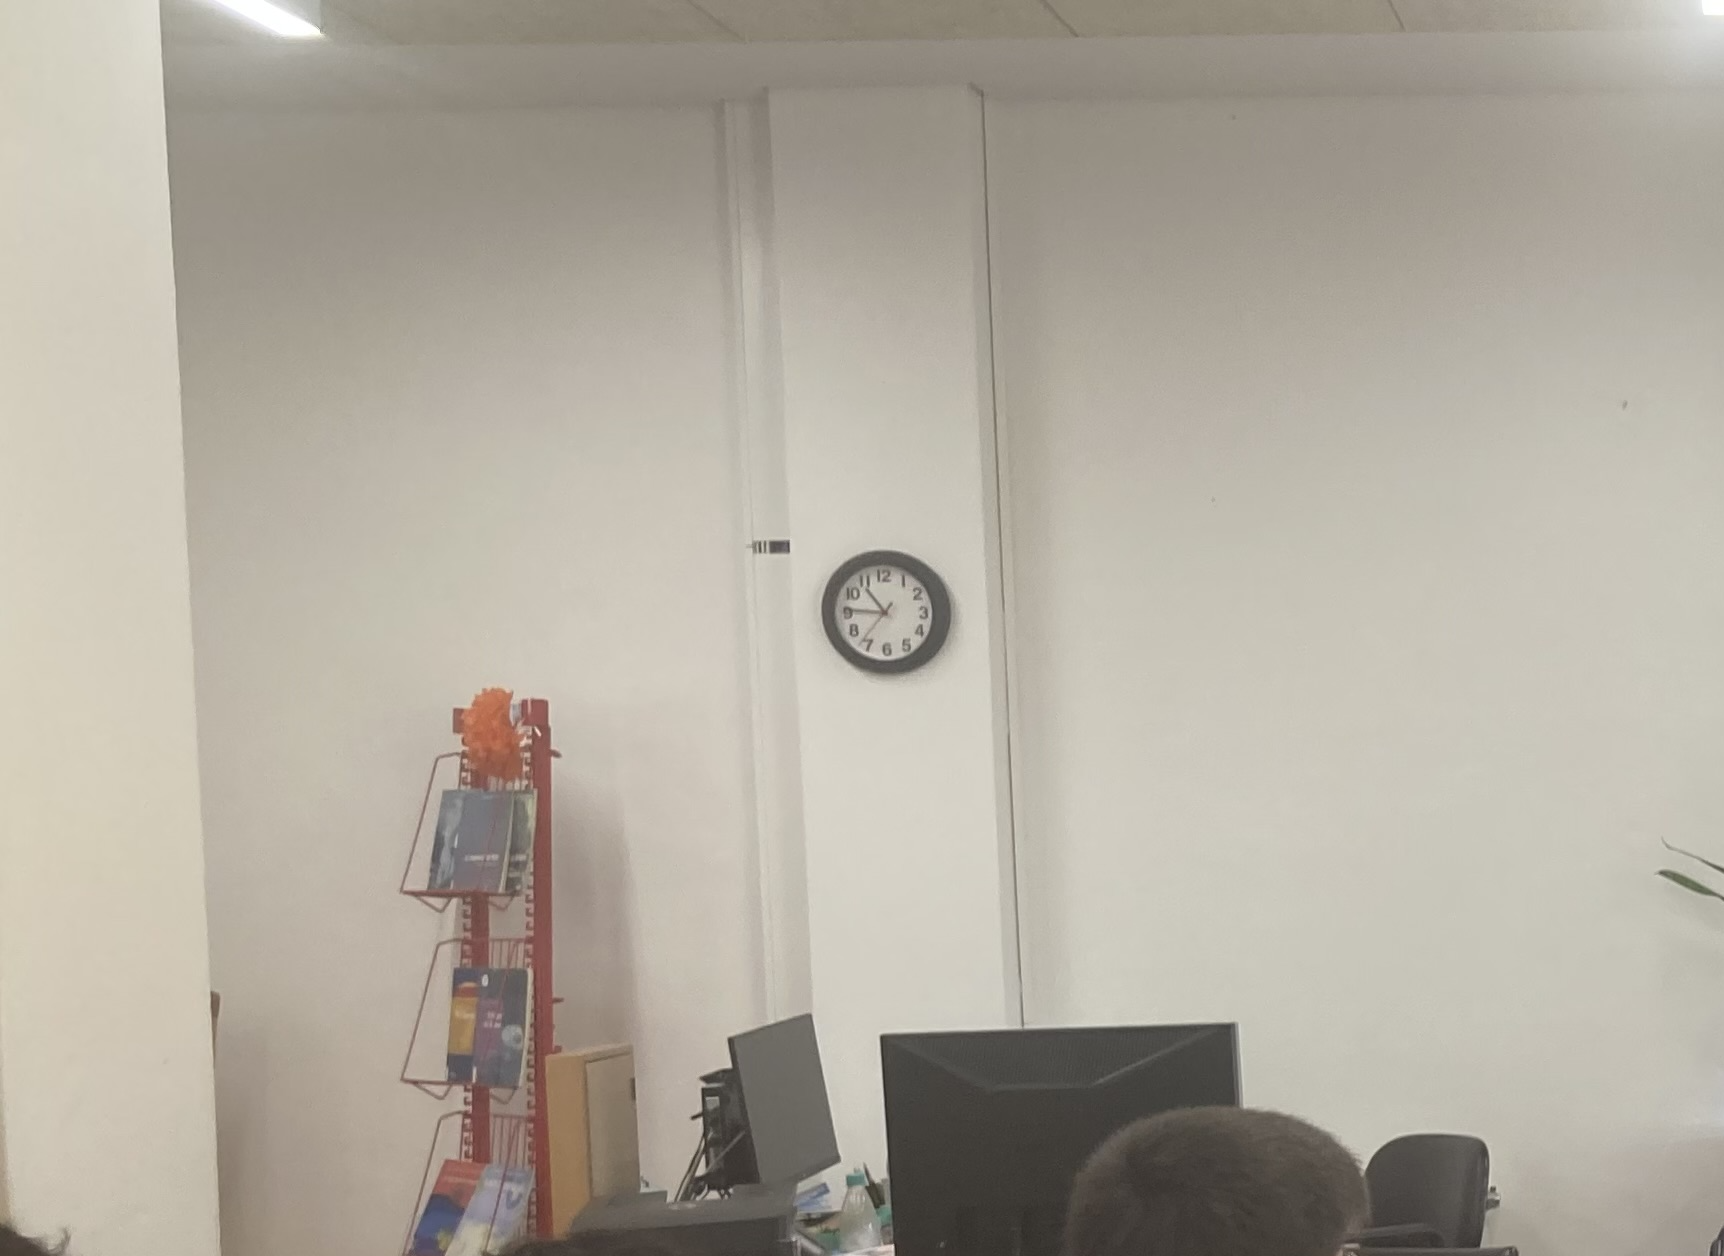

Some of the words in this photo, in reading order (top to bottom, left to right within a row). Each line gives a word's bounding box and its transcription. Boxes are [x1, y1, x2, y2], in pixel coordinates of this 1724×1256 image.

[859, 575, 871, 588] 11
[876, 569, 892, 583] 12
[901, 574, 906, 588] 1
[846, 587, 861, 601] 10
[912, 587, 923, 601] 2
[842, 605, 854, 620] 9
[918, 606, 929, 620] 3
[849, 624, 859, 637] 8
[914, 624, 924, 638] 4
[863, 639, 874, 652] 7
[882, 643, 892, 656] 6
[901, 638, 912, 652] 5
